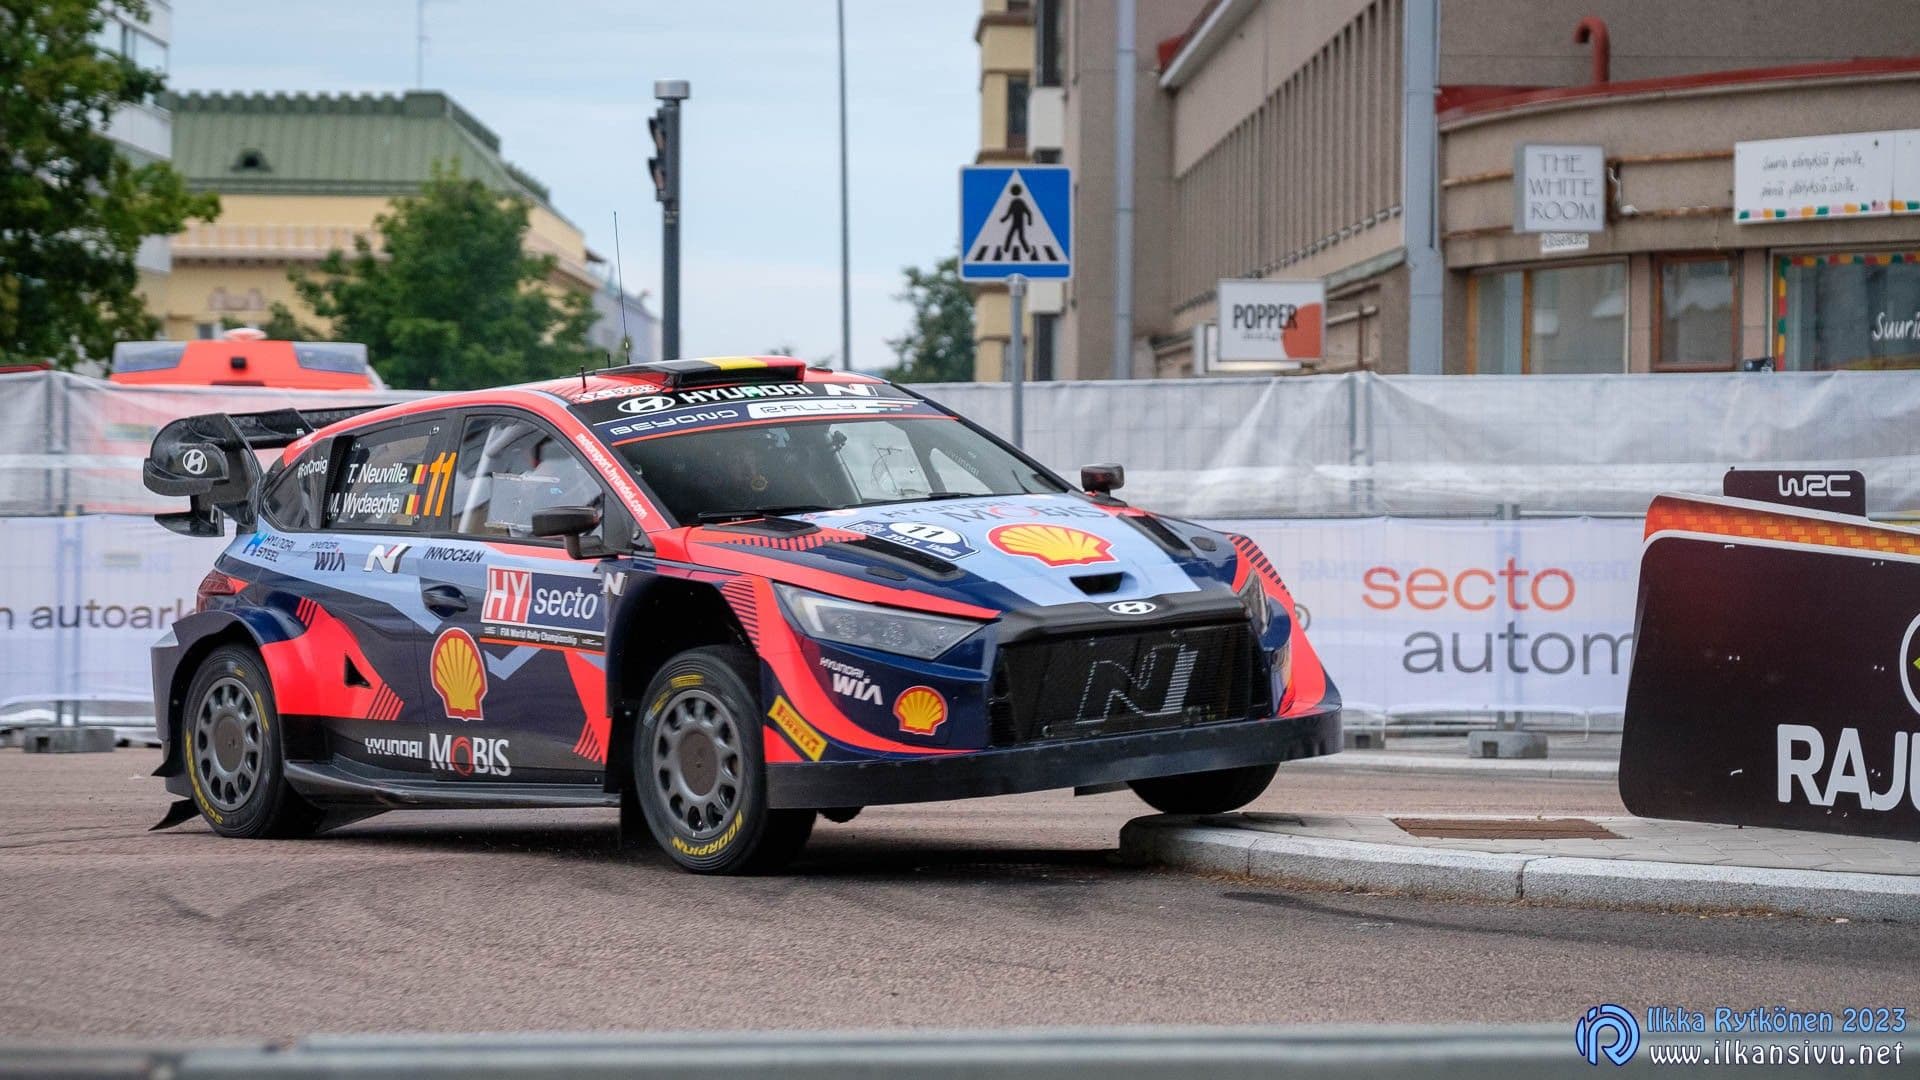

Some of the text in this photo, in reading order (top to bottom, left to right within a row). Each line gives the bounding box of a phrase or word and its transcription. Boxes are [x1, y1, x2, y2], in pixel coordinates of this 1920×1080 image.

[1538, 154, 1585, 173] THE
[1528, 178, 1599, 197] WHITE
[1530, 201, 1596, 220] ROOM
[1232, 303, 1298, 329] POPPER
[679, 383, 814, 403] HYUNDAI
[609, 409, 739, 436] BEYOND
[347, 462, 408, 485] T. Neuville
[422, 451, 457, 517] 11
[1778, 475, 1851, 497] WRC
[328, 492, 400, 519] M. Wydaeghe
[255, 547, 280, 562] STEEL
[263, 535, 297, 552] HYUNDAI
[423, 546, 486, 564] INNOCEAN
[314, 550, 347, 572] WIA
[485, 570, 599, 621] HY secto
[1361, 557, 1576, 612] secto
[819, 656, 865, 679] HYUNDAI
[832, 673, 884, 706] WIA
[364, 733, 512, 777] HYUNDAI MOBIS
[1777, 723, 1920, 812] RAJ
